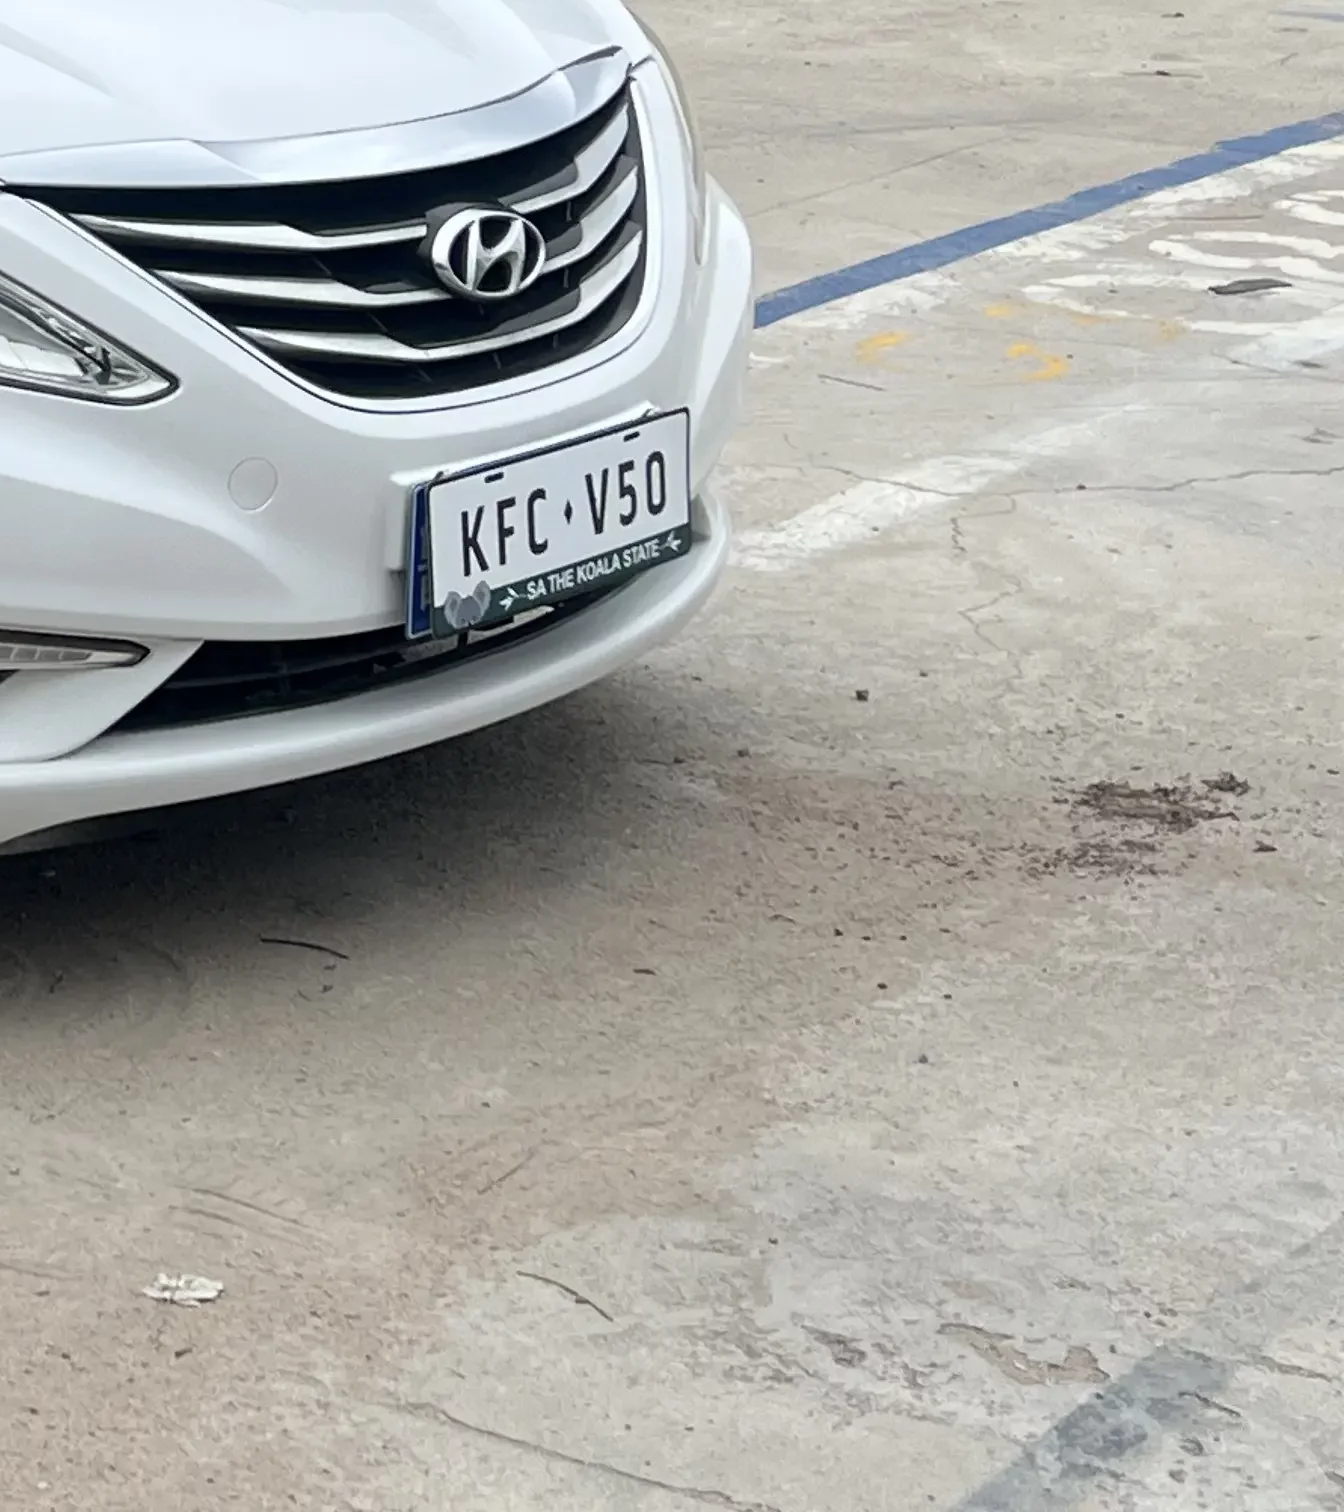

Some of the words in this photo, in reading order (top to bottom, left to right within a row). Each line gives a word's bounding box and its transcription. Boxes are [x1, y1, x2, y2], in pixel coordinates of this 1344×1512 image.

[460, 487, 549, 578] KFC
[584, 450, 667, 535] V50
[524, 577, 547, 601] SA
[547, 568, 575, 592] THE
[576, 553, 621, 585] KOALA
[622, 539, 661, 569] STATE
